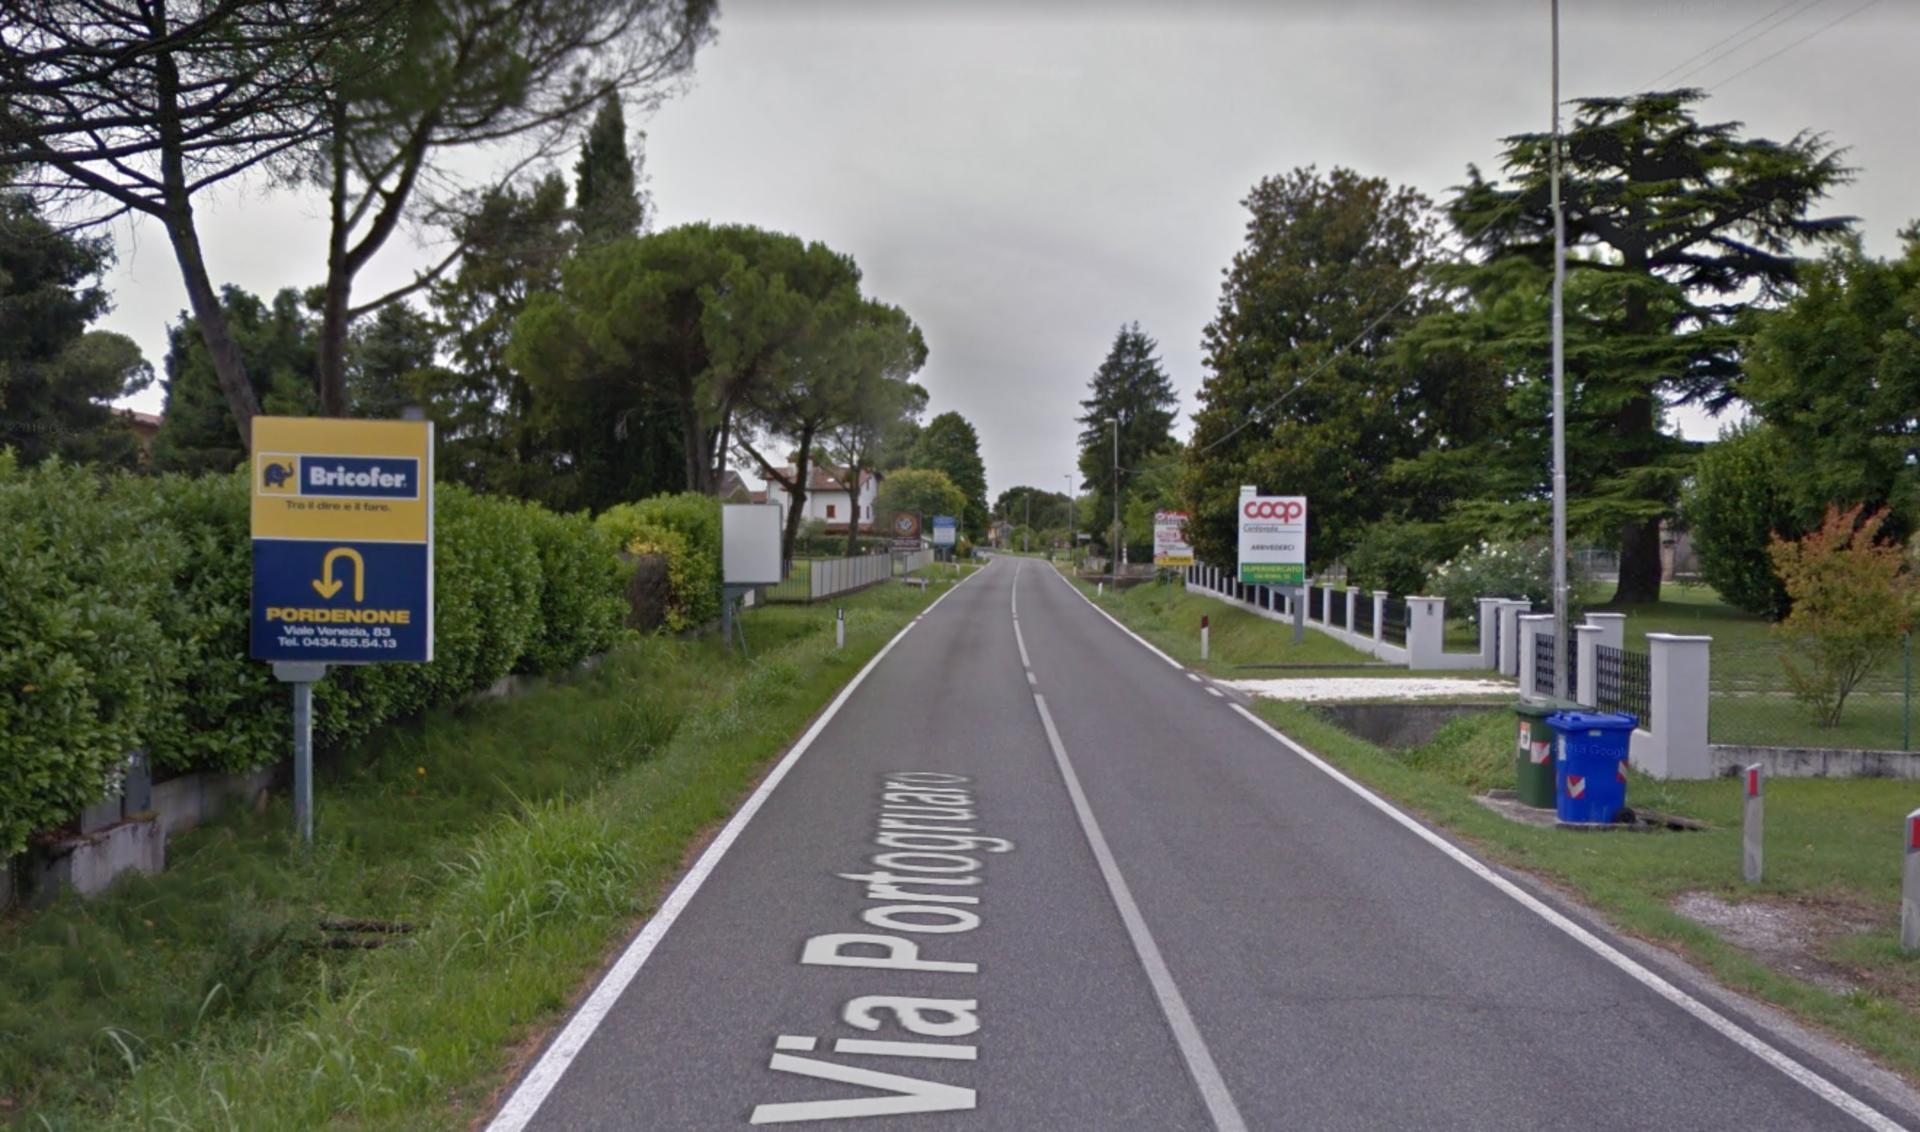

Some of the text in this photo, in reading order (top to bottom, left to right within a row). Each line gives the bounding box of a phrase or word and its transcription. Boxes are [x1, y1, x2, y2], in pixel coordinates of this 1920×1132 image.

[309, 466, 406, 488] Bricofer
[286, 500, 305, 510] Tra
[317, 501, 341, 511] dire
[344, 503, 351, 511] e
[1243, 501, 1303, 523] coop
[1250, 543, 1295, 552] ARRIVEDERCI
[265, 606, 411, 624] PORDENONE
[283, 625, 391, 638] Viale Venezia, 83
[278, 636, 397, 648] Tel. 0434.55.54.13
